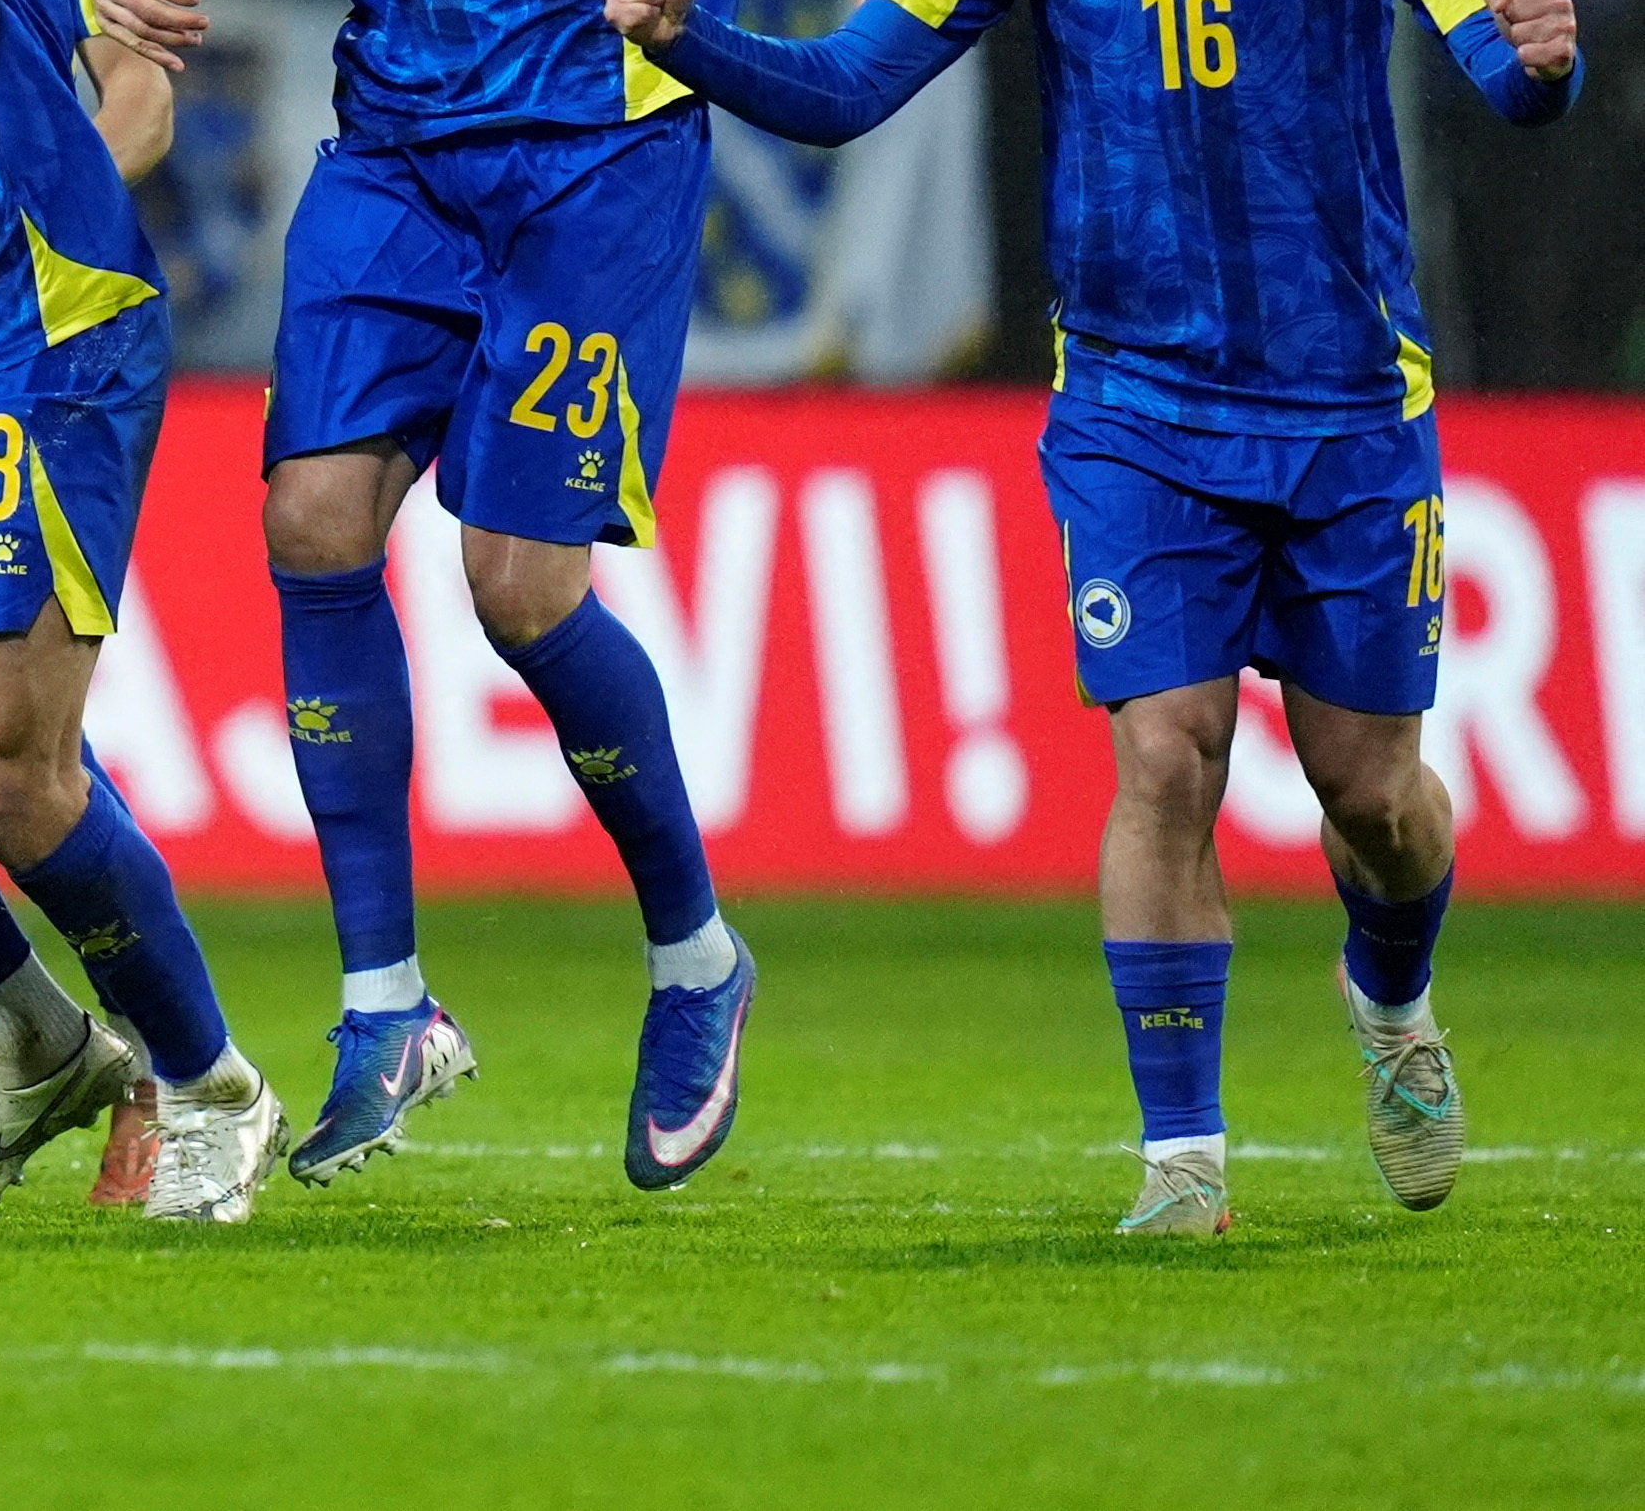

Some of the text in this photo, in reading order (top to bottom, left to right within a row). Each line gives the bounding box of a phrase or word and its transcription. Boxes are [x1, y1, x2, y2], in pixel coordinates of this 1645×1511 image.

[509, 322, 620, 439] 23
[565, 476, 606, 493] KELME
[1403, 494, 1445, 608] 16
[1140, 1014, 1204, 1031] KELME
